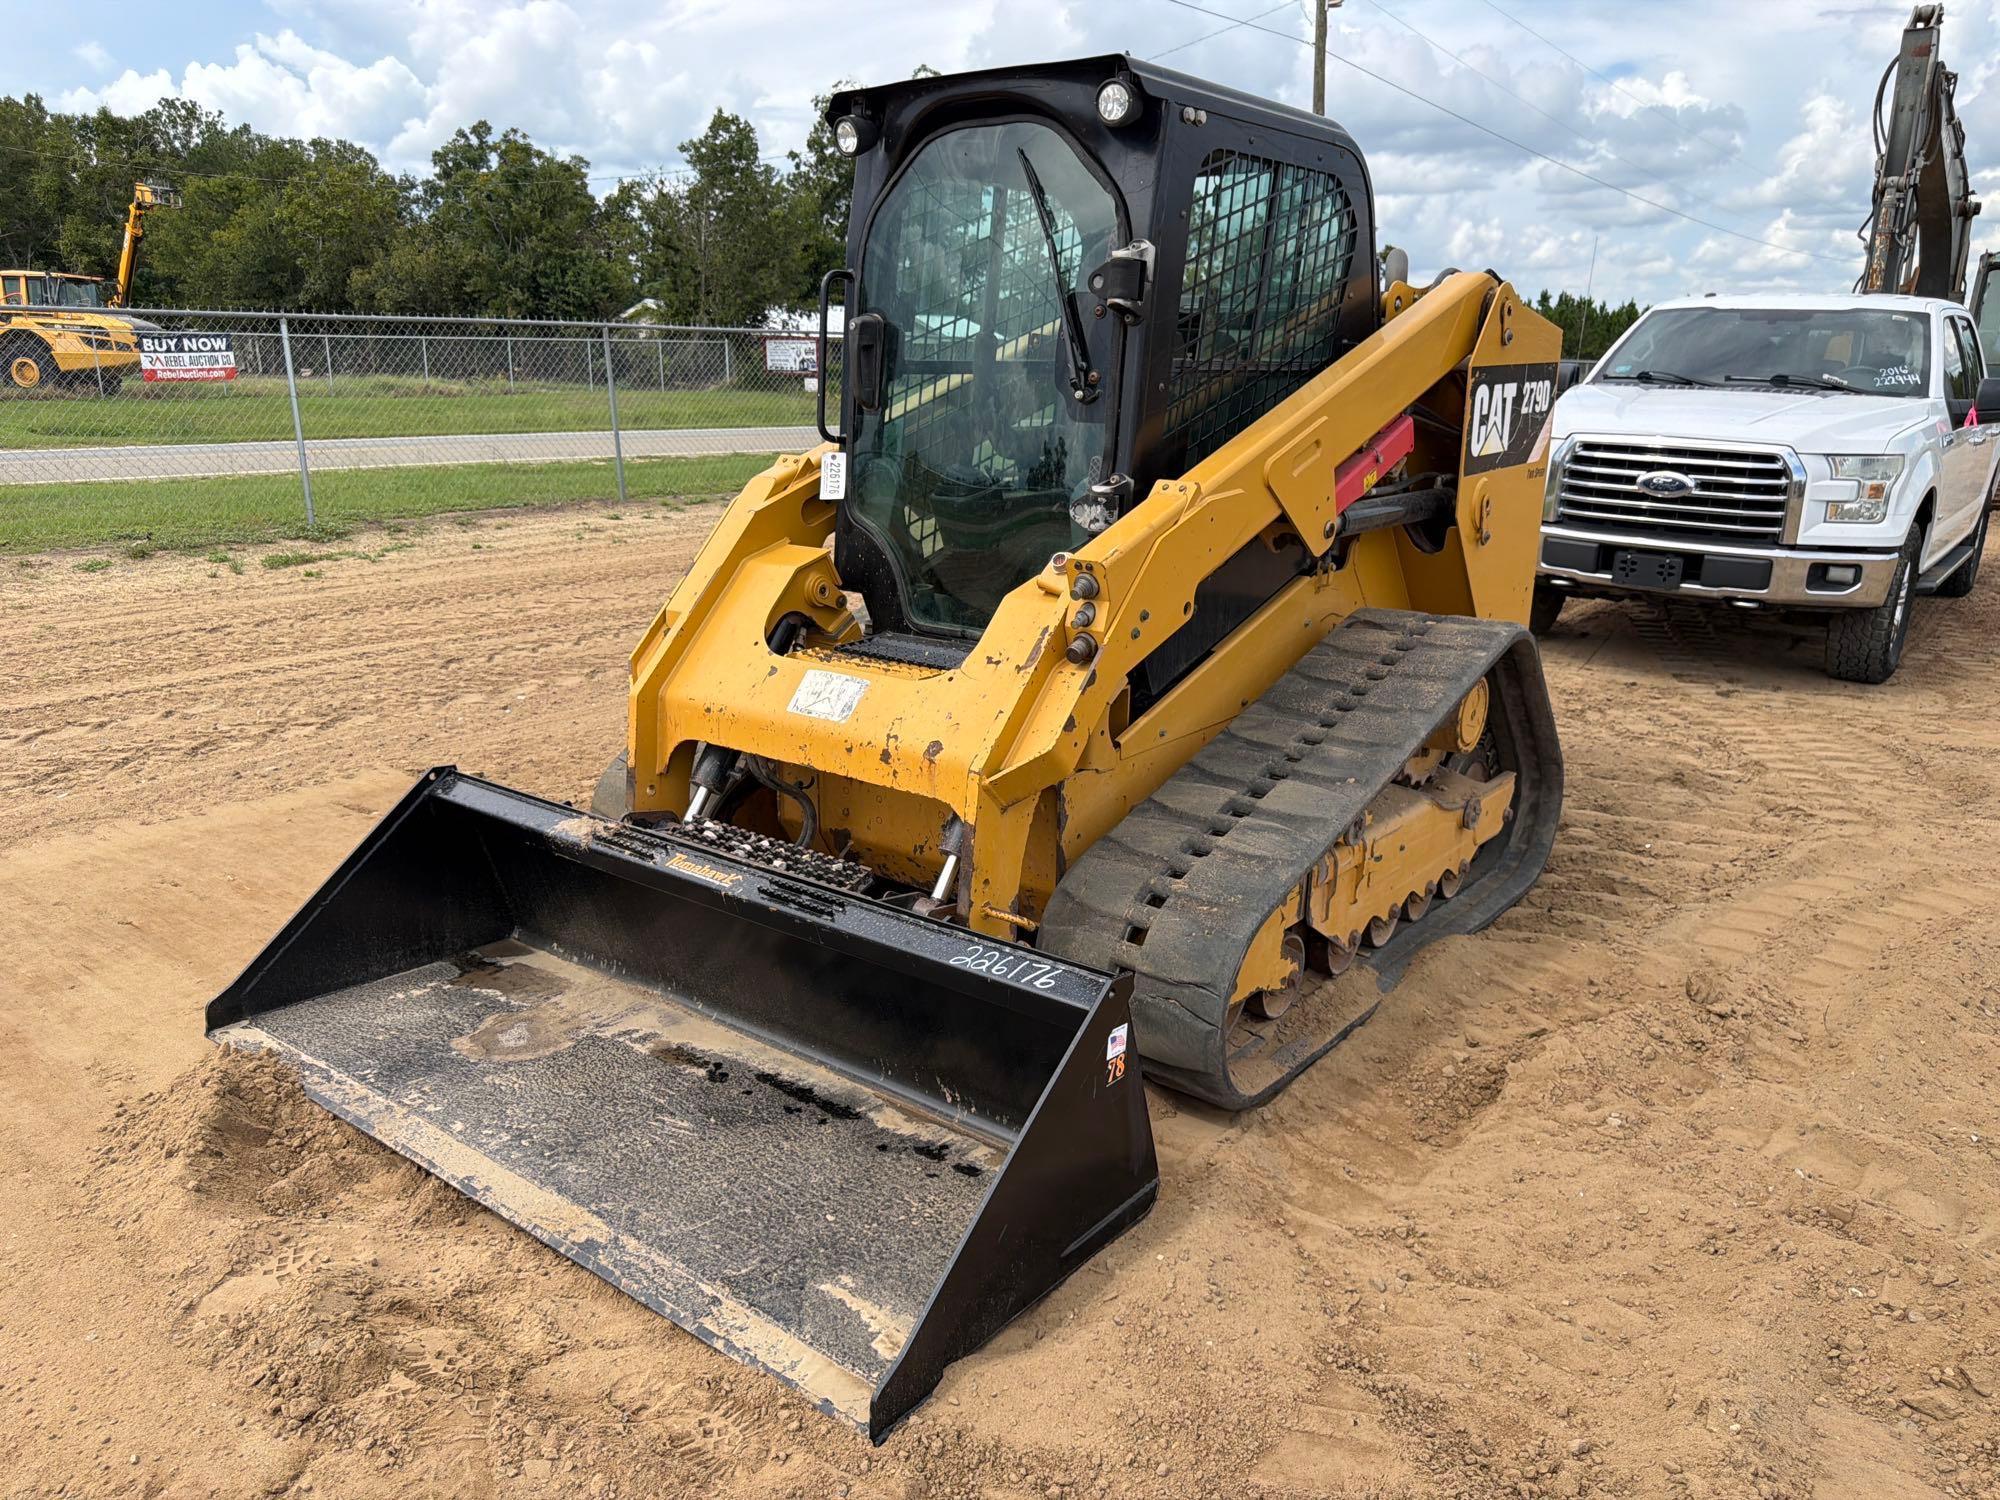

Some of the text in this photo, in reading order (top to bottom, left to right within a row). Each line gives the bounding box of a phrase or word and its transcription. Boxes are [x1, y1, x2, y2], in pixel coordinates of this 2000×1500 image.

[142, 338, 227, 352] BUY NOW
[157, 369, 226, 380] RebelAuction.com
[164, 355, 188, 367] REBEL
[189, 355, 219, 367] AUCTION
[1879, 365, 1909, 378] 2016
[1873, 373, 1921, 387] 222944
[1521, 379, 1551, 415] 279D
[1471, 382, 1518, 458] CAT
[829, 462, 841, 494] 226176
[665, 852, 743, 885] Tomahawk
[949, 946, 1063, 989] 226176
[1107, 1053, 1126, 1084] 78
